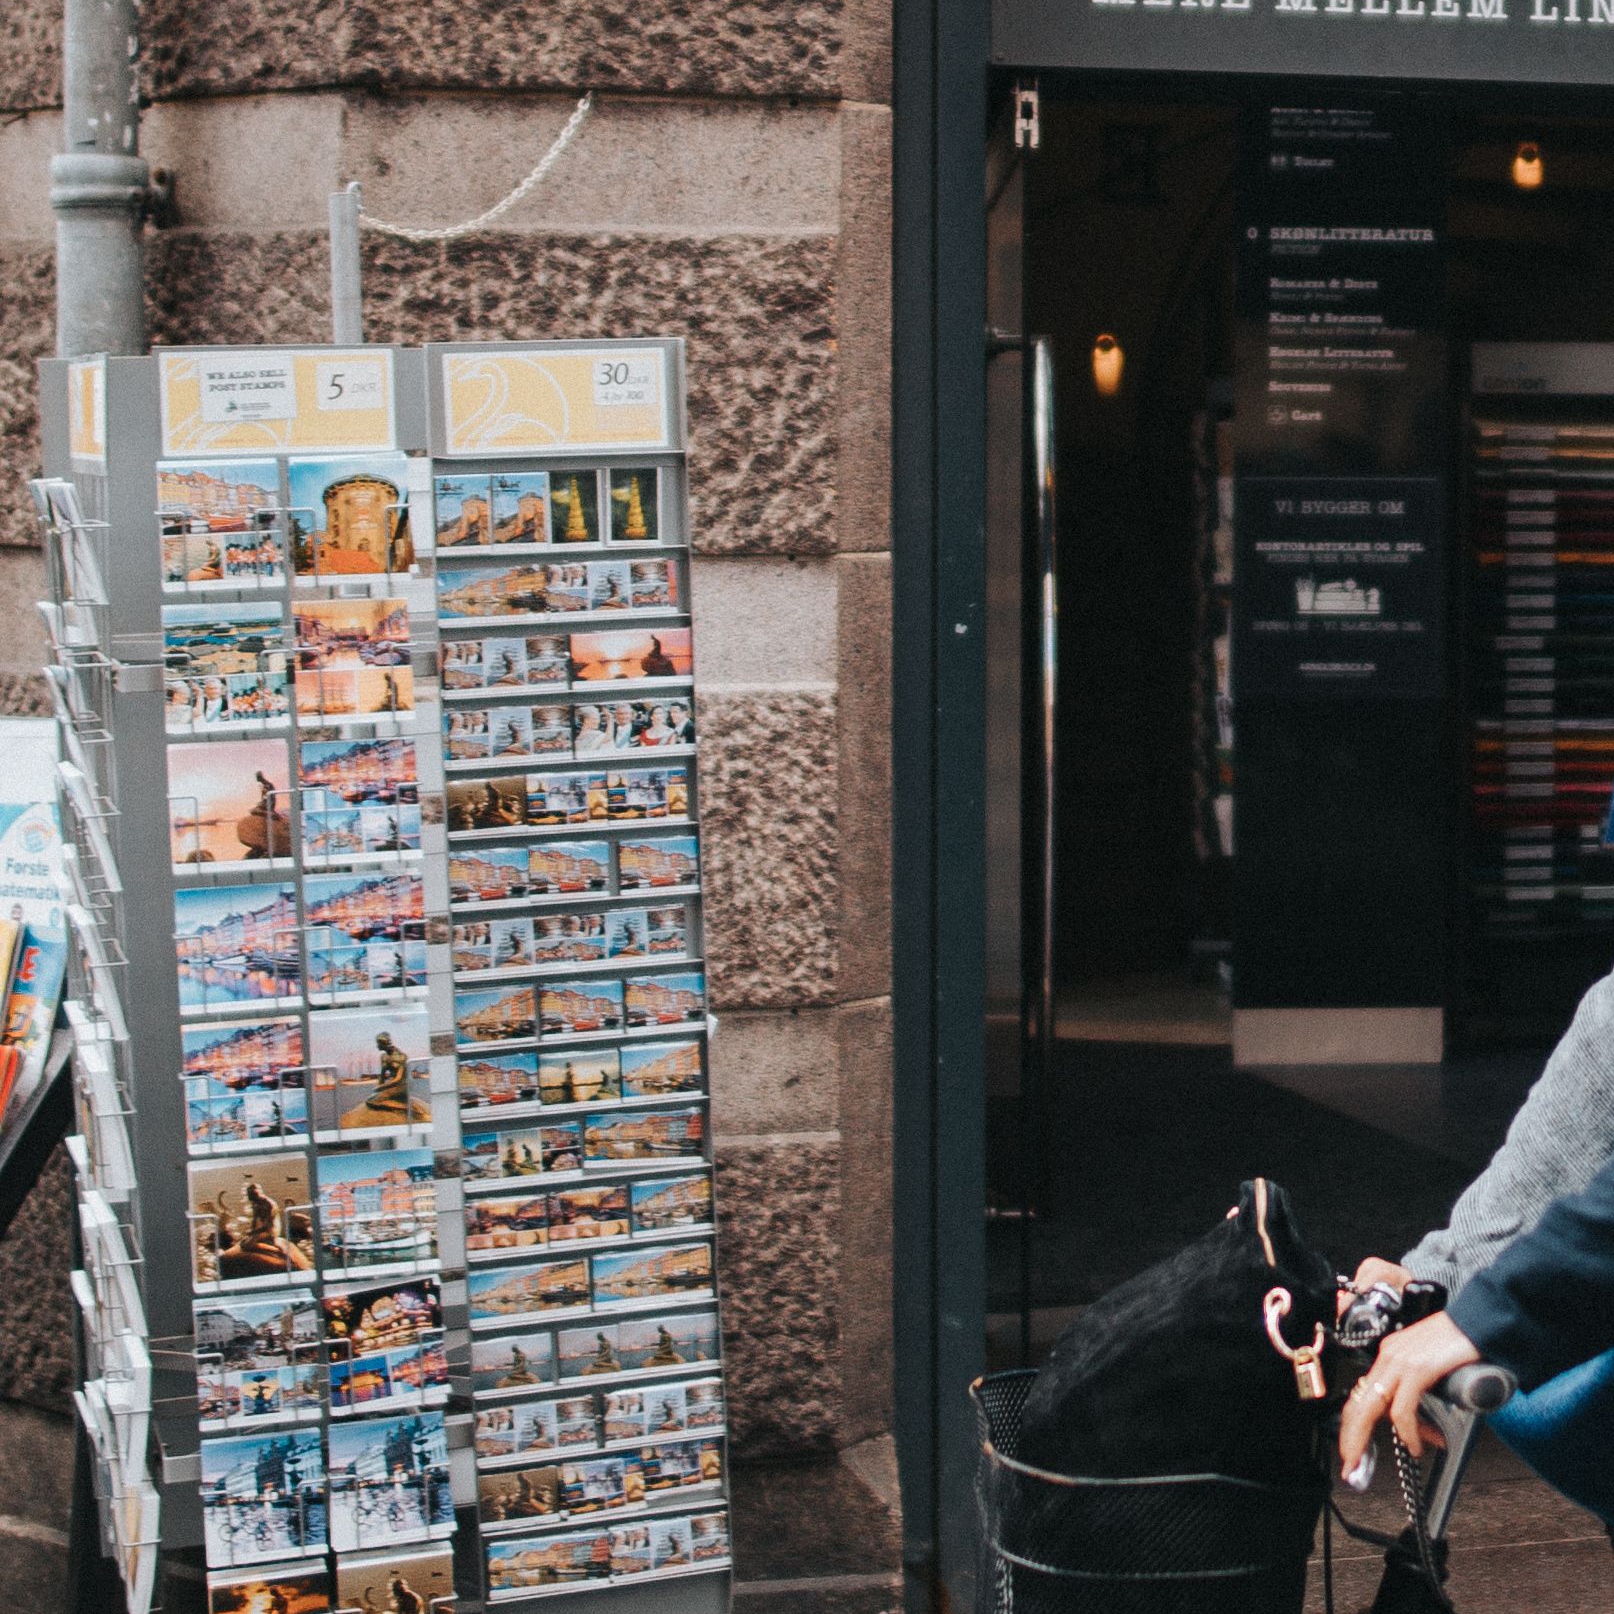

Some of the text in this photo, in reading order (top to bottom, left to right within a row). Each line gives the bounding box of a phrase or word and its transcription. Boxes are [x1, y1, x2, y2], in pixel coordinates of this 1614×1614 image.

[206, 369, 287, 380] WE ALSO SELL
[599, 362, 630, 386] 30
[208, 381, 287, 393] POST STAMPS
[327, 373, 346, 401] 5
[1273, 500, 1406, 515] VI BYGGER OM
